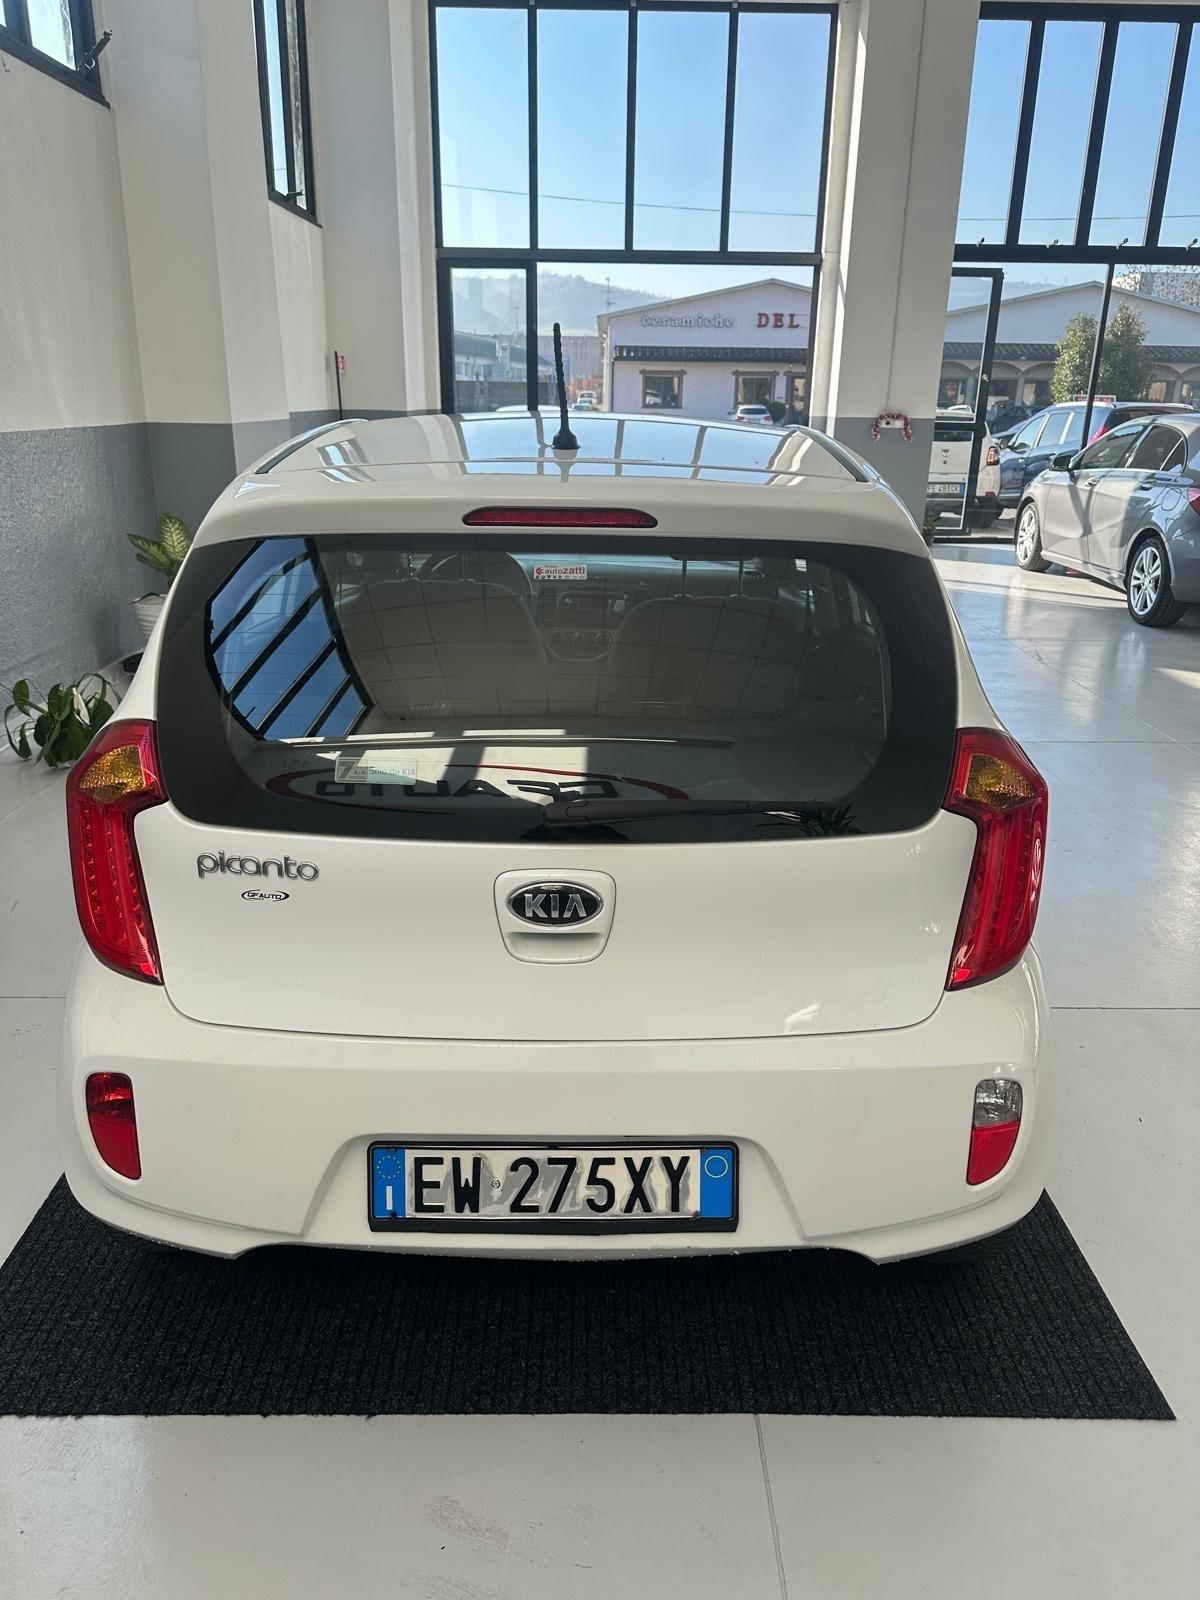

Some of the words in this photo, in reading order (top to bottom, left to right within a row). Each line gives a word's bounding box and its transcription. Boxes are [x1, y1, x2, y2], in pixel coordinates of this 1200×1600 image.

[641, 312, 735, 329] ceramiche
[756, 313, 800, 329] DEL
[197, 850, 320, 881] picanto
[524, 892, 587, 918] KIA
[508, 1156, 691, 1214] 275XY
